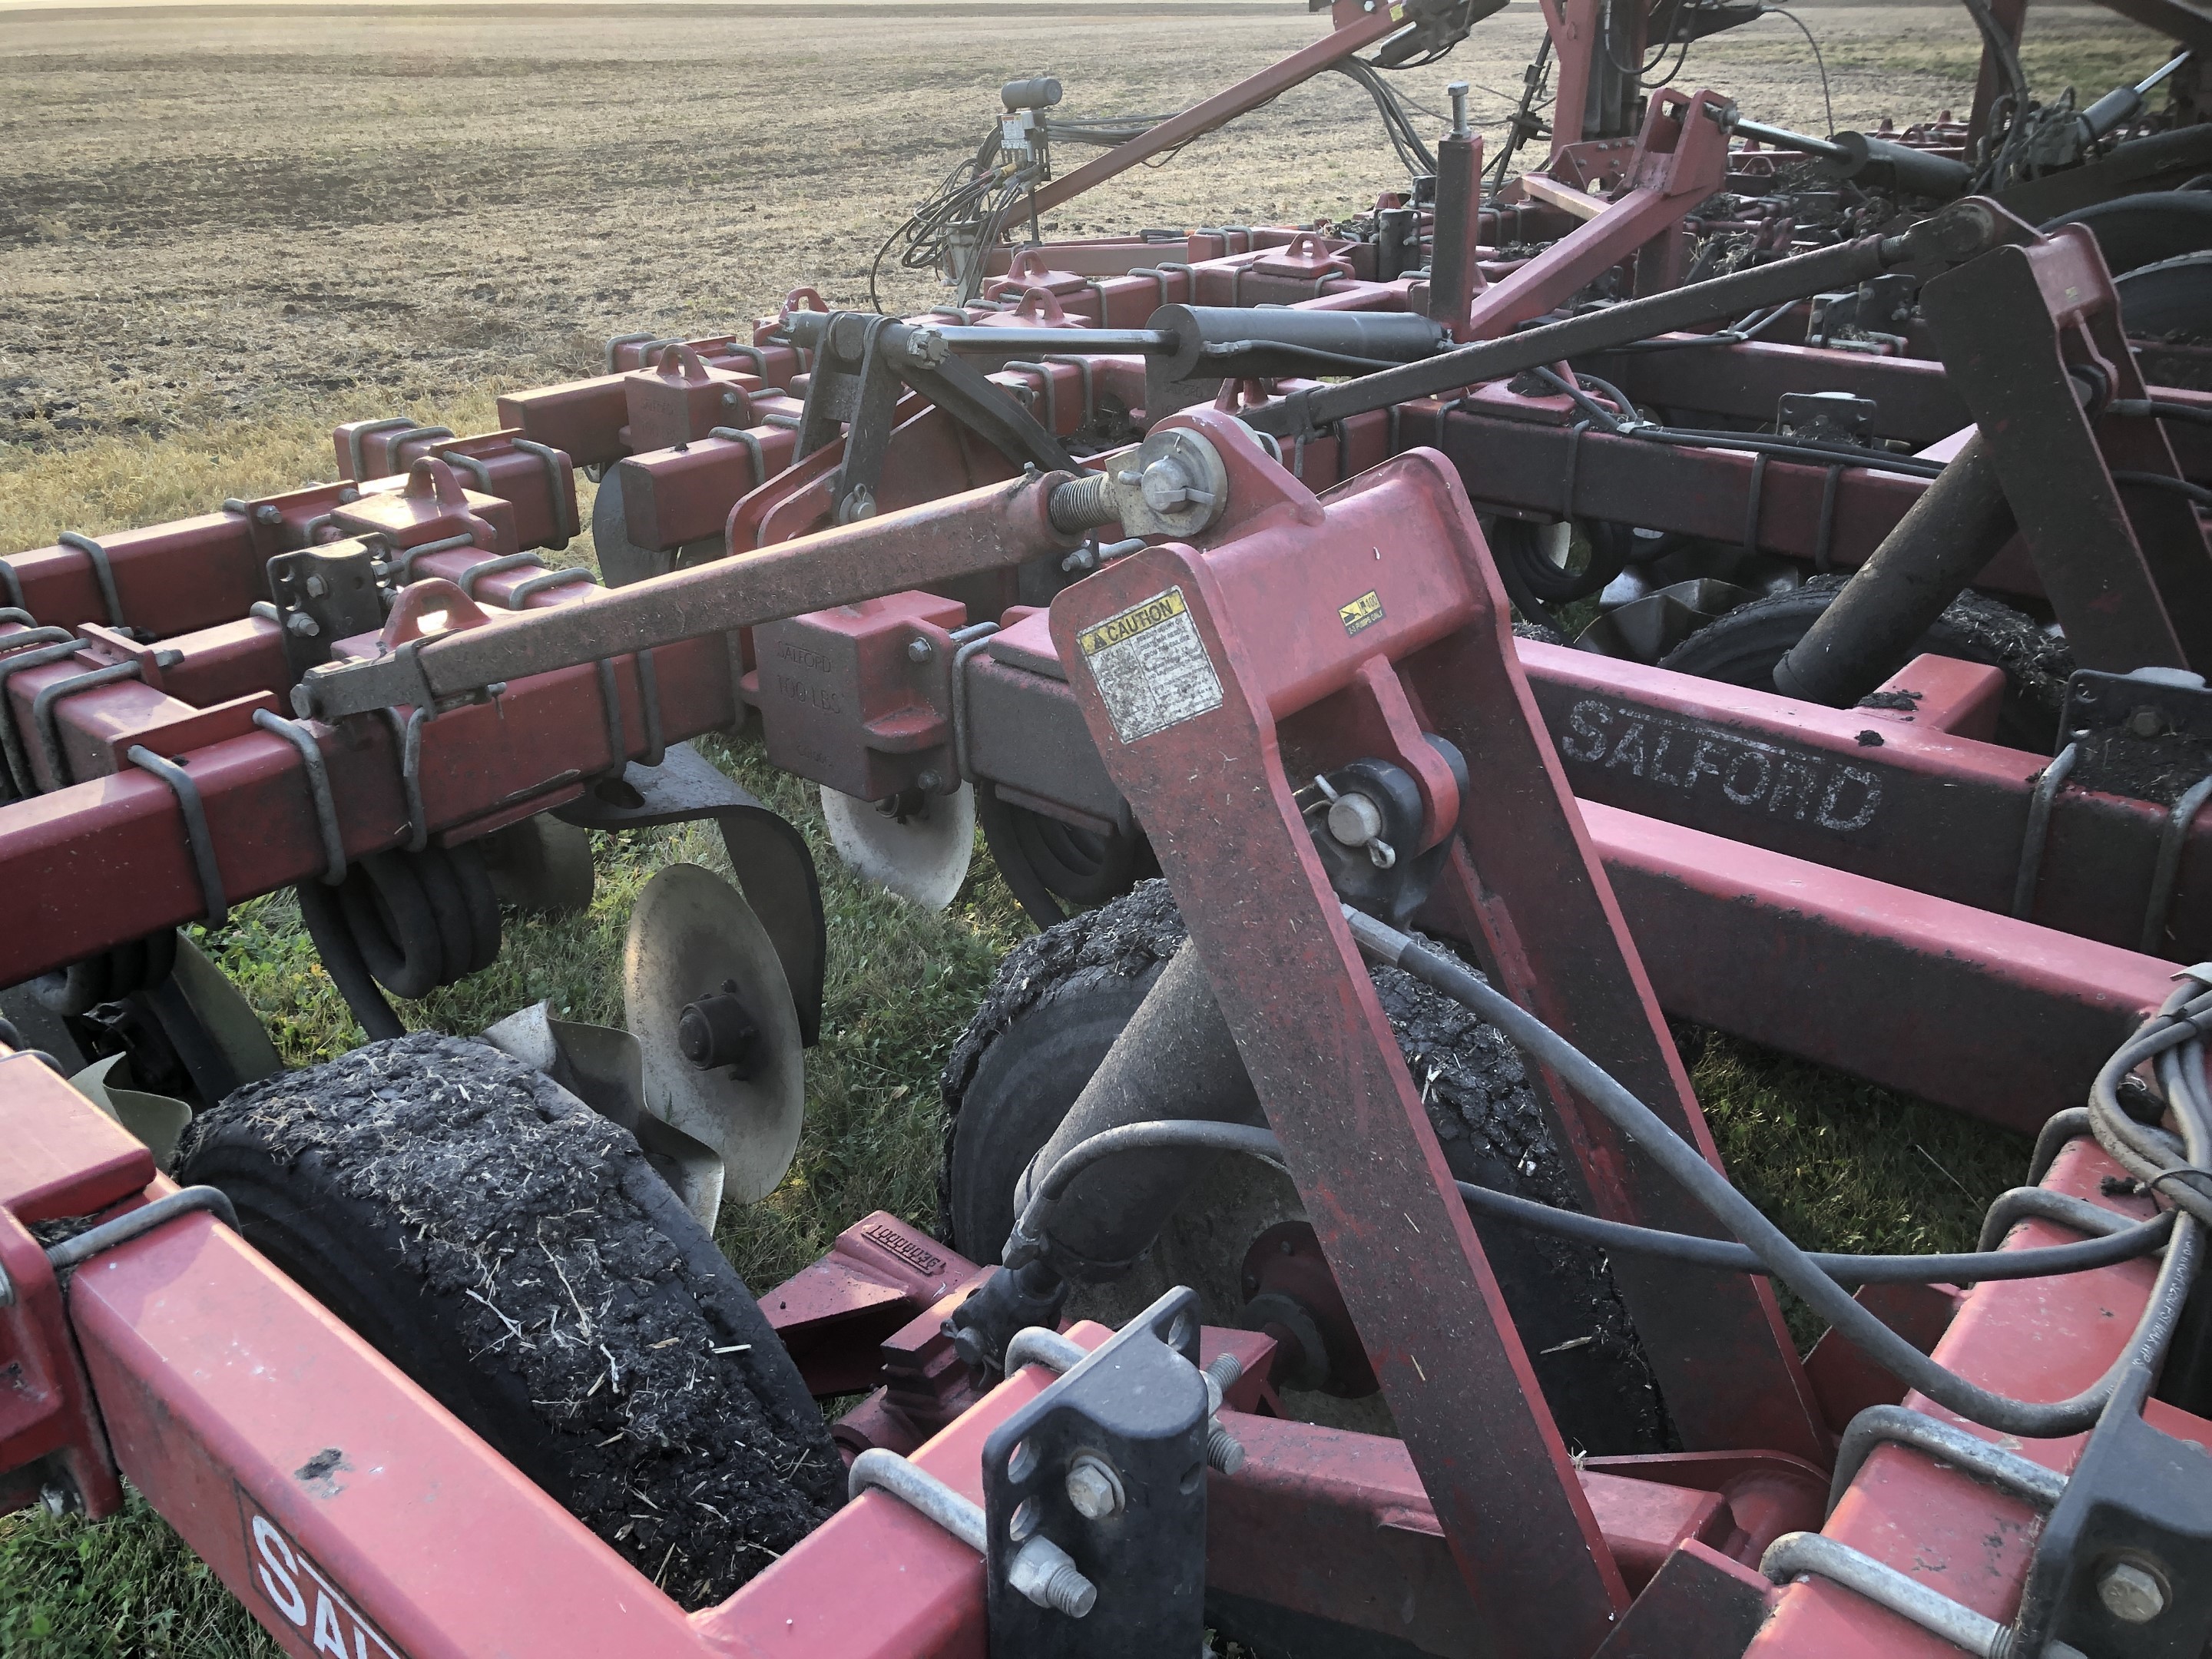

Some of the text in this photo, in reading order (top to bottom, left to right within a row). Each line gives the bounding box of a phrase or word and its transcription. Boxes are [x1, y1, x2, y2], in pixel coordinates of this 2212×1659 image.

[1107, 599, 1174, 642] CAUTION
[1371, 609, 1383, 621] ONLY
[777, 641, 831, 673] SALFORD
[1561, 700, 1883, 832] SALFORD
[2158, 1305, 2175, 1324] PSI
[2147, 1323, 2166, 1345] MAX
